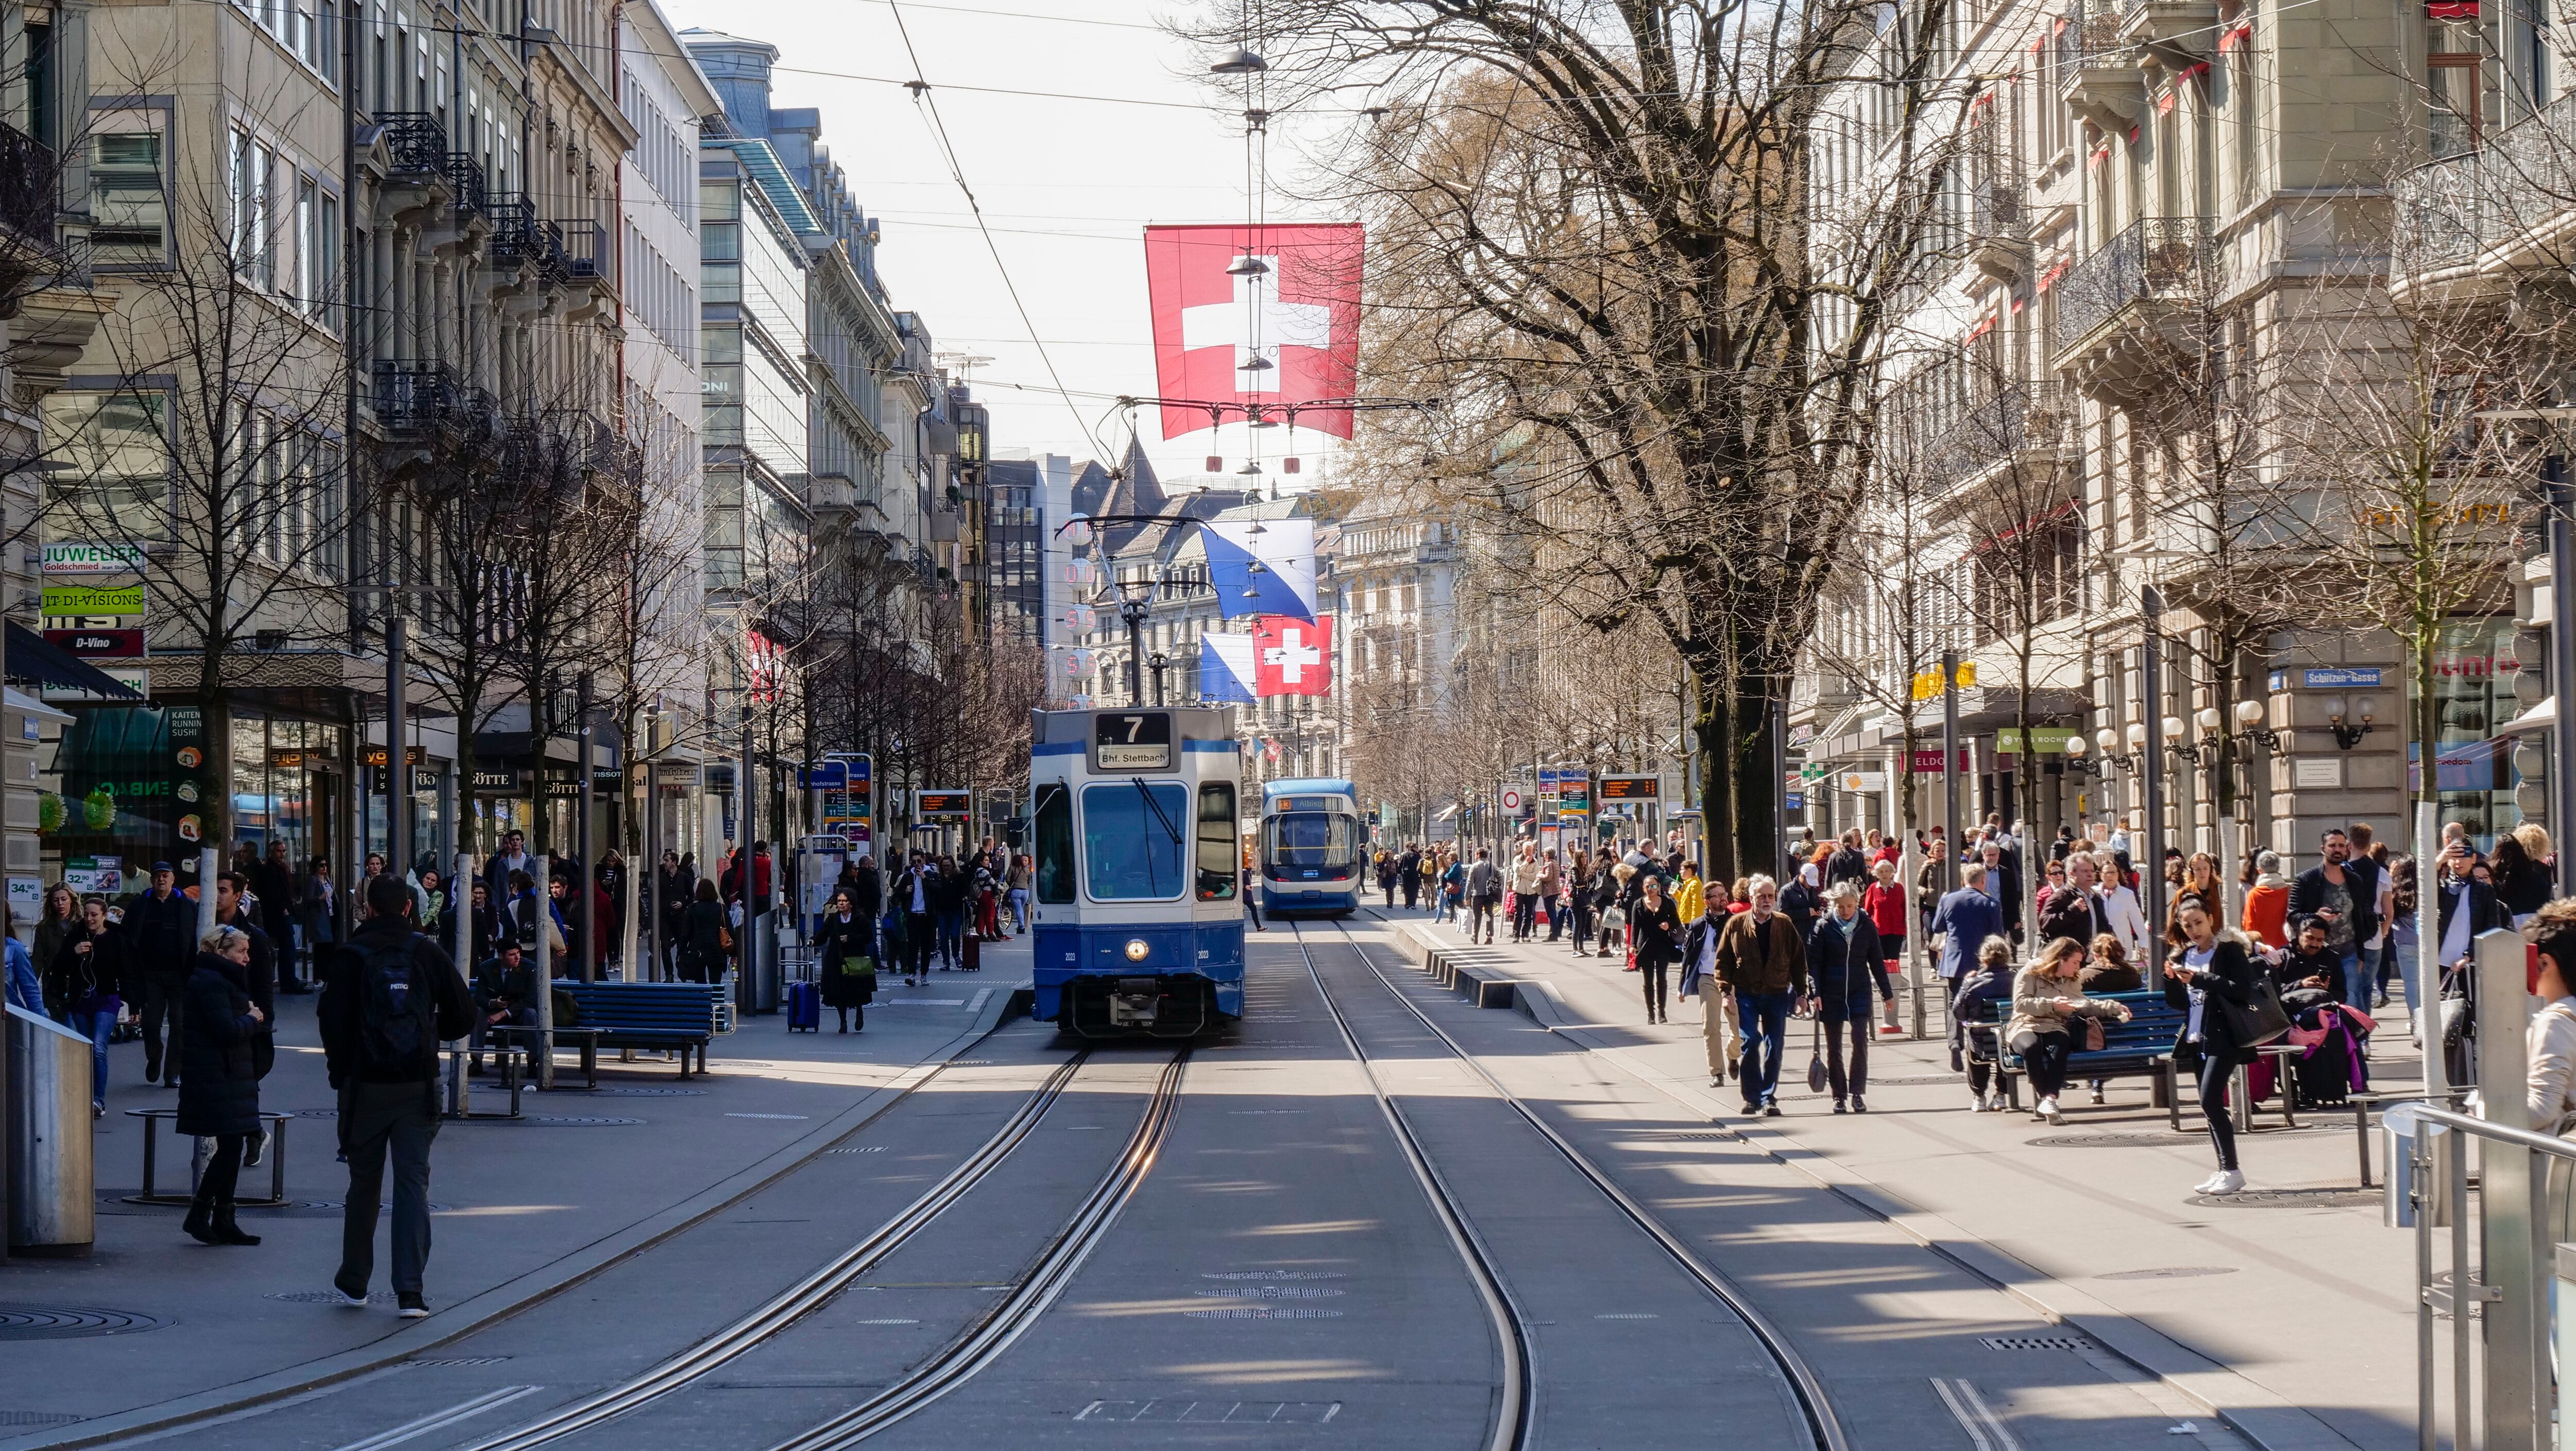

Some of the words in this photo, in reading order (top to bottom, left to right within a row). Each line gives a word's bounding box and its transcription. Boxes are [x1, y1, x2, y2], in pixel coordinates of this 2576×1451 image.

[44, 547, 140, 562] JUWELIER
[46, 596, 59, 606] IT
[63, 595, 140, 606] DI-VISIONS
[76, 637, 110, 648] D-Vino
[1124, 717, 1143, 743] 7
[1123, 754, 1166, 763] Stettbach
[1065, 952, 1076, 961] 2023
[1198, 950, 1209, 959] 2023
